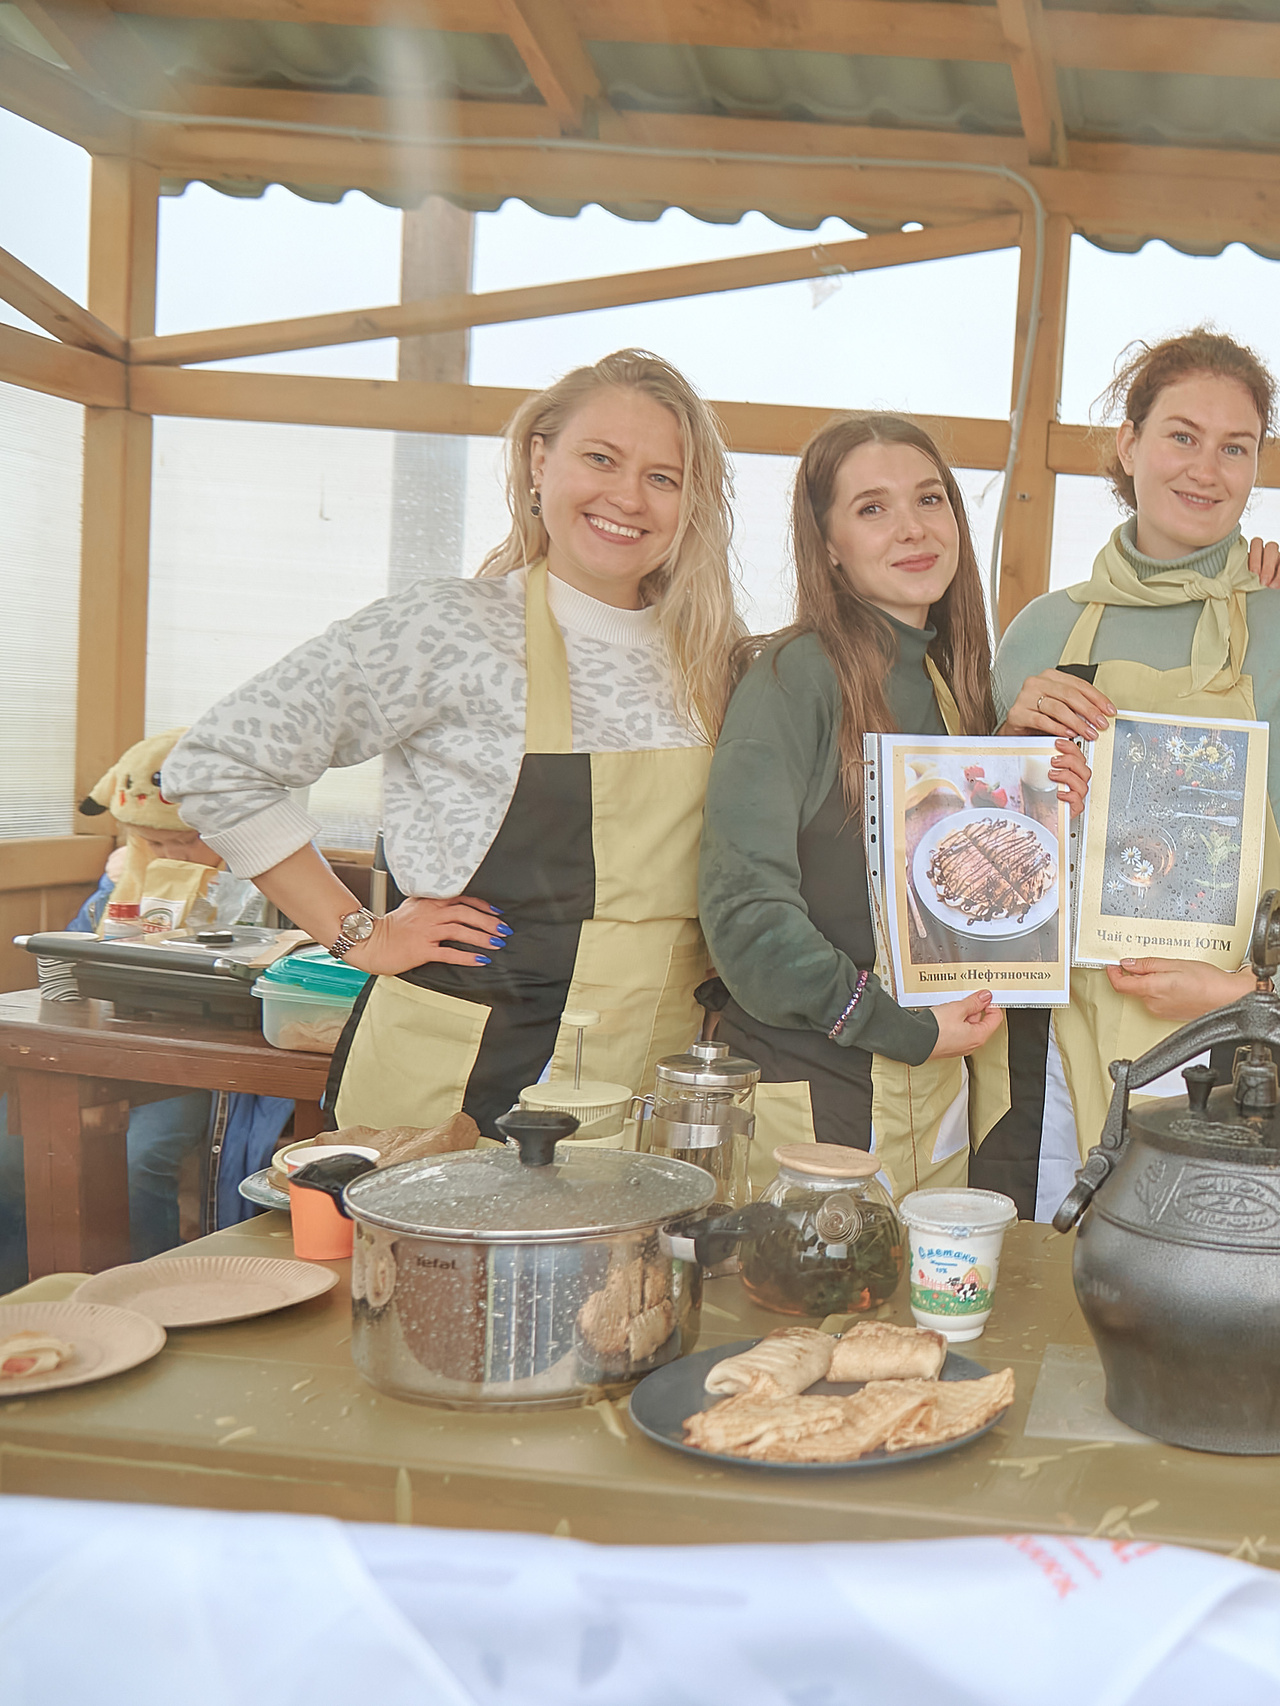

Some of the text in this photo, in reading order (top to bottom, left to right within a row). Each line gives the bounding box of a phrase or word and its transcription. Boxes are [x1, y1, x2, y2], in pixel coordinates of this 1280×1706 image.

[1097, 929, 1232, 951] Чай с травами ЮТМ
[919, 969, 1051, 983] Блины «Нефтяночка»
[414, 1255, 459, 1270] Tefal
[918, 1246, 978, 1265] Сметана
